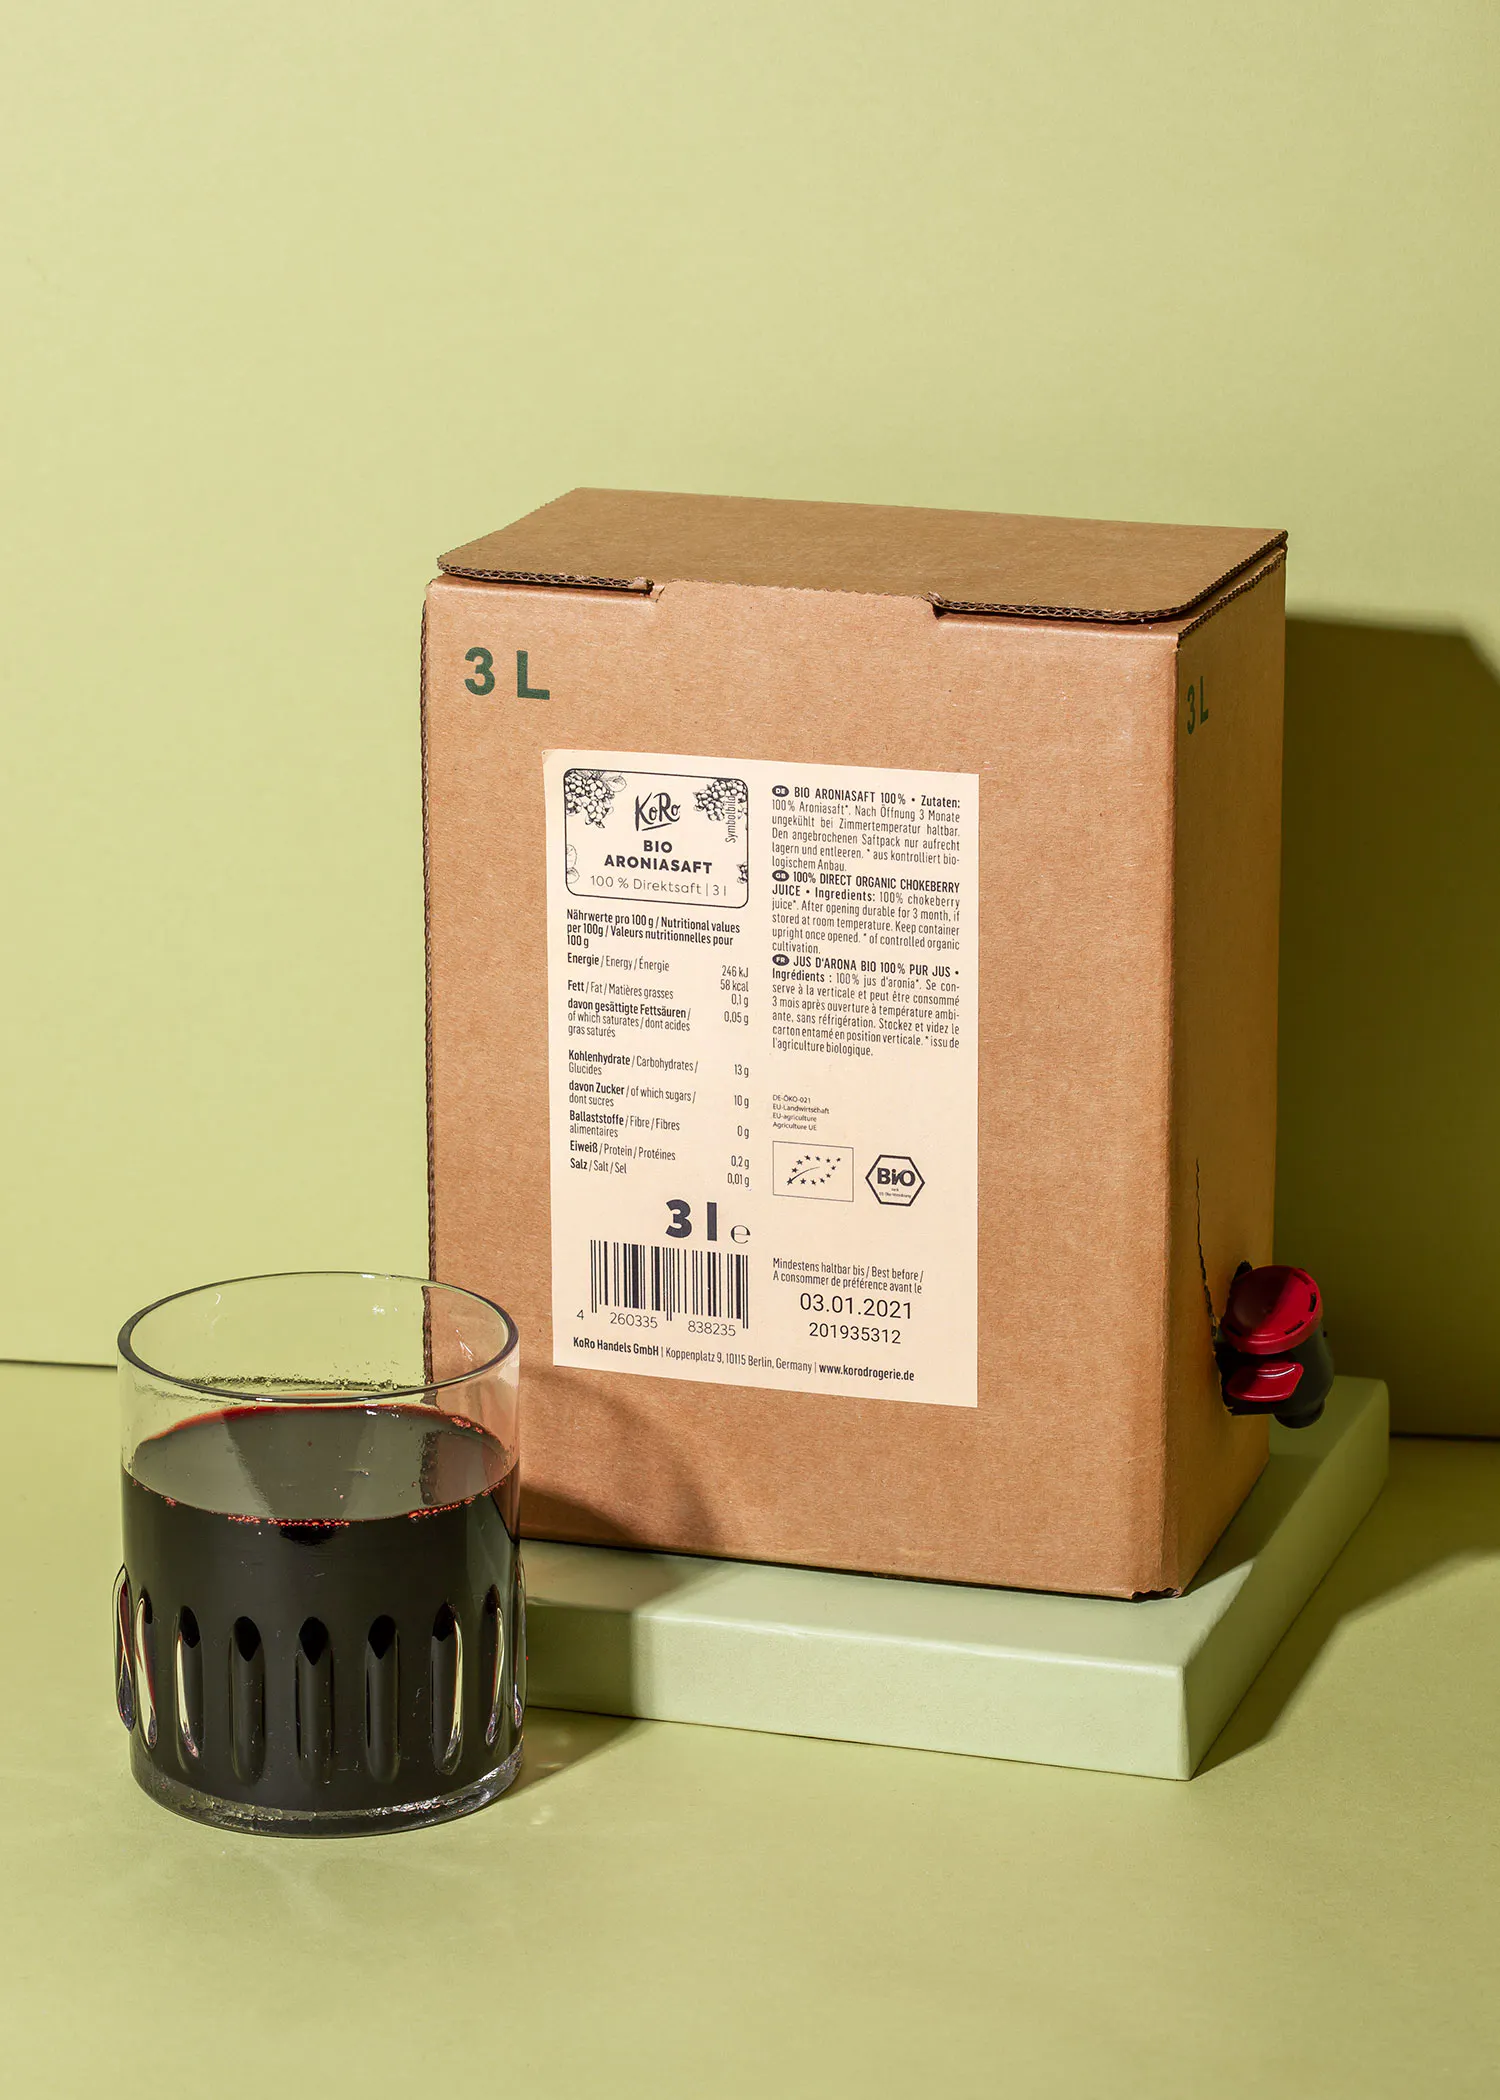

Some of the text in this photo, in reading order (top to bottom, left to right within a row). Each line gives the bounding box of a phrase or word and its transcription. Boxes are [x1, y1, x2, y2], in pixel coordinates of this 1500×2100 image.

[464, 646, 550, 700] 3 L
[1186, 676, 1208, 735] 3 L
[794, 786, 960, 808] BIO ARONIASAFT Zutaten:
[634, 792, 681, 832] KoRo
[725, 796, 738, 844] Symbolbild
[855, 804, 960, 822] Nach Öffnung Monate
[771, 815, 959, 836] ungekühlt Zimmertemperatur haltbar.
[643, 840, 672, 853] BIO
[772, 827, 959, 851] Den angebrochenen Saftpack nur aufrecht
[772, 841, 940, 864] lagern und entleeren. aus kontrolliert
[772, 855, 846, 871] logischem Anbau.
[603, 854, 712, 874] ARONIASAFT
[590, 875, 701, 894] 100 Direktsaft
[819, 872, 959, 893] DIRECT ORGANIC CHOKEBERRY
[771, 883, 960, 910] JUICE Ingredients: chokeberry
[566, 908, 740, 933] Nährwerte pro 100 Nutritional values
[801, 900, 950, 921] After opening durable month,
[566, 923, 733, 946] per Valeurs nutritionnelles pour
[772, 913, 959, 936] stored room temperature. Keep container
[566, 935, 581, 946] 100
[772, 926, 959, 951] upright once opened. controlled organic
[772, 940, 820, 954] cultivation.
[567, 952, 669, 973] Energie Energy Énergie
[721, 964, 736, 977] 246
[793, 955, 950, 977] JUS BIO PUR JUS
[732, 980, 748, 992] kcal
[772, 967, 876, 988] Ingrédients jus
[567, 979, 673, 999] Fett Fat Matières grasses
[772, 984, 959, 1006] serve verticale peut être consommé
[567, 997, 686, 1018] davon gesättigte Fettsäuren
[779, 997, 932, 1018] mois après ouverture température
[568, 1025, 615, 1037] gras saturés
[577, 1012, 690, 1031] which saturates dont acides
[796, 1013, 948, 1033] sans réfrigération. Stockez videz
[772, 1025, 923, 1046] carton entamé position verticale.
[826, 1041, 873, 1057] biologique.
[568, 1049, 693, 1071] Kohlenhydrate Carbohydrates
[568, 1062, 602, 1075] Glucides
[568, 1079, 691, 1102] davon Zucker which sugars
[568, 1092, 614, 1107] dont sucres
[772, 1094, 810, 1103] DE-ÖKO-021
[772, 1103, 829, 1114] EU-Landwirtschaft
[772, 1112, 816, 1122] EU-agriculture
[569, 1109, 680, 1130] Ballaststoffe Fibre Fibres
[569, 1123, 618, 1137] alimentaires
[772, 1121, 807, 1130] Agriculture
[569, 1139, 675, 1160] Eiweiß Protein Protéines
[570, 1157, 626, 1174] Salz Salt Sel
[665, 1198, 692, 1238] 3
[772, 1257, 918, 1280] Mindestens haltbar Best before
[780, 1273, 912, 1293] consommer préférence avant
[800, 1292, 910, 1319] 03.01.2021
[610, 1311, 658, 1328] 260335
[687, 1320, 736, 1336] 838235
[809, 1322, 900, 1344] 201935312
[573, 1336, 914, 1381] KoRo Handels GmbH Koppenplatz 10115 Berlin, Germany www.korodrogerie.de
